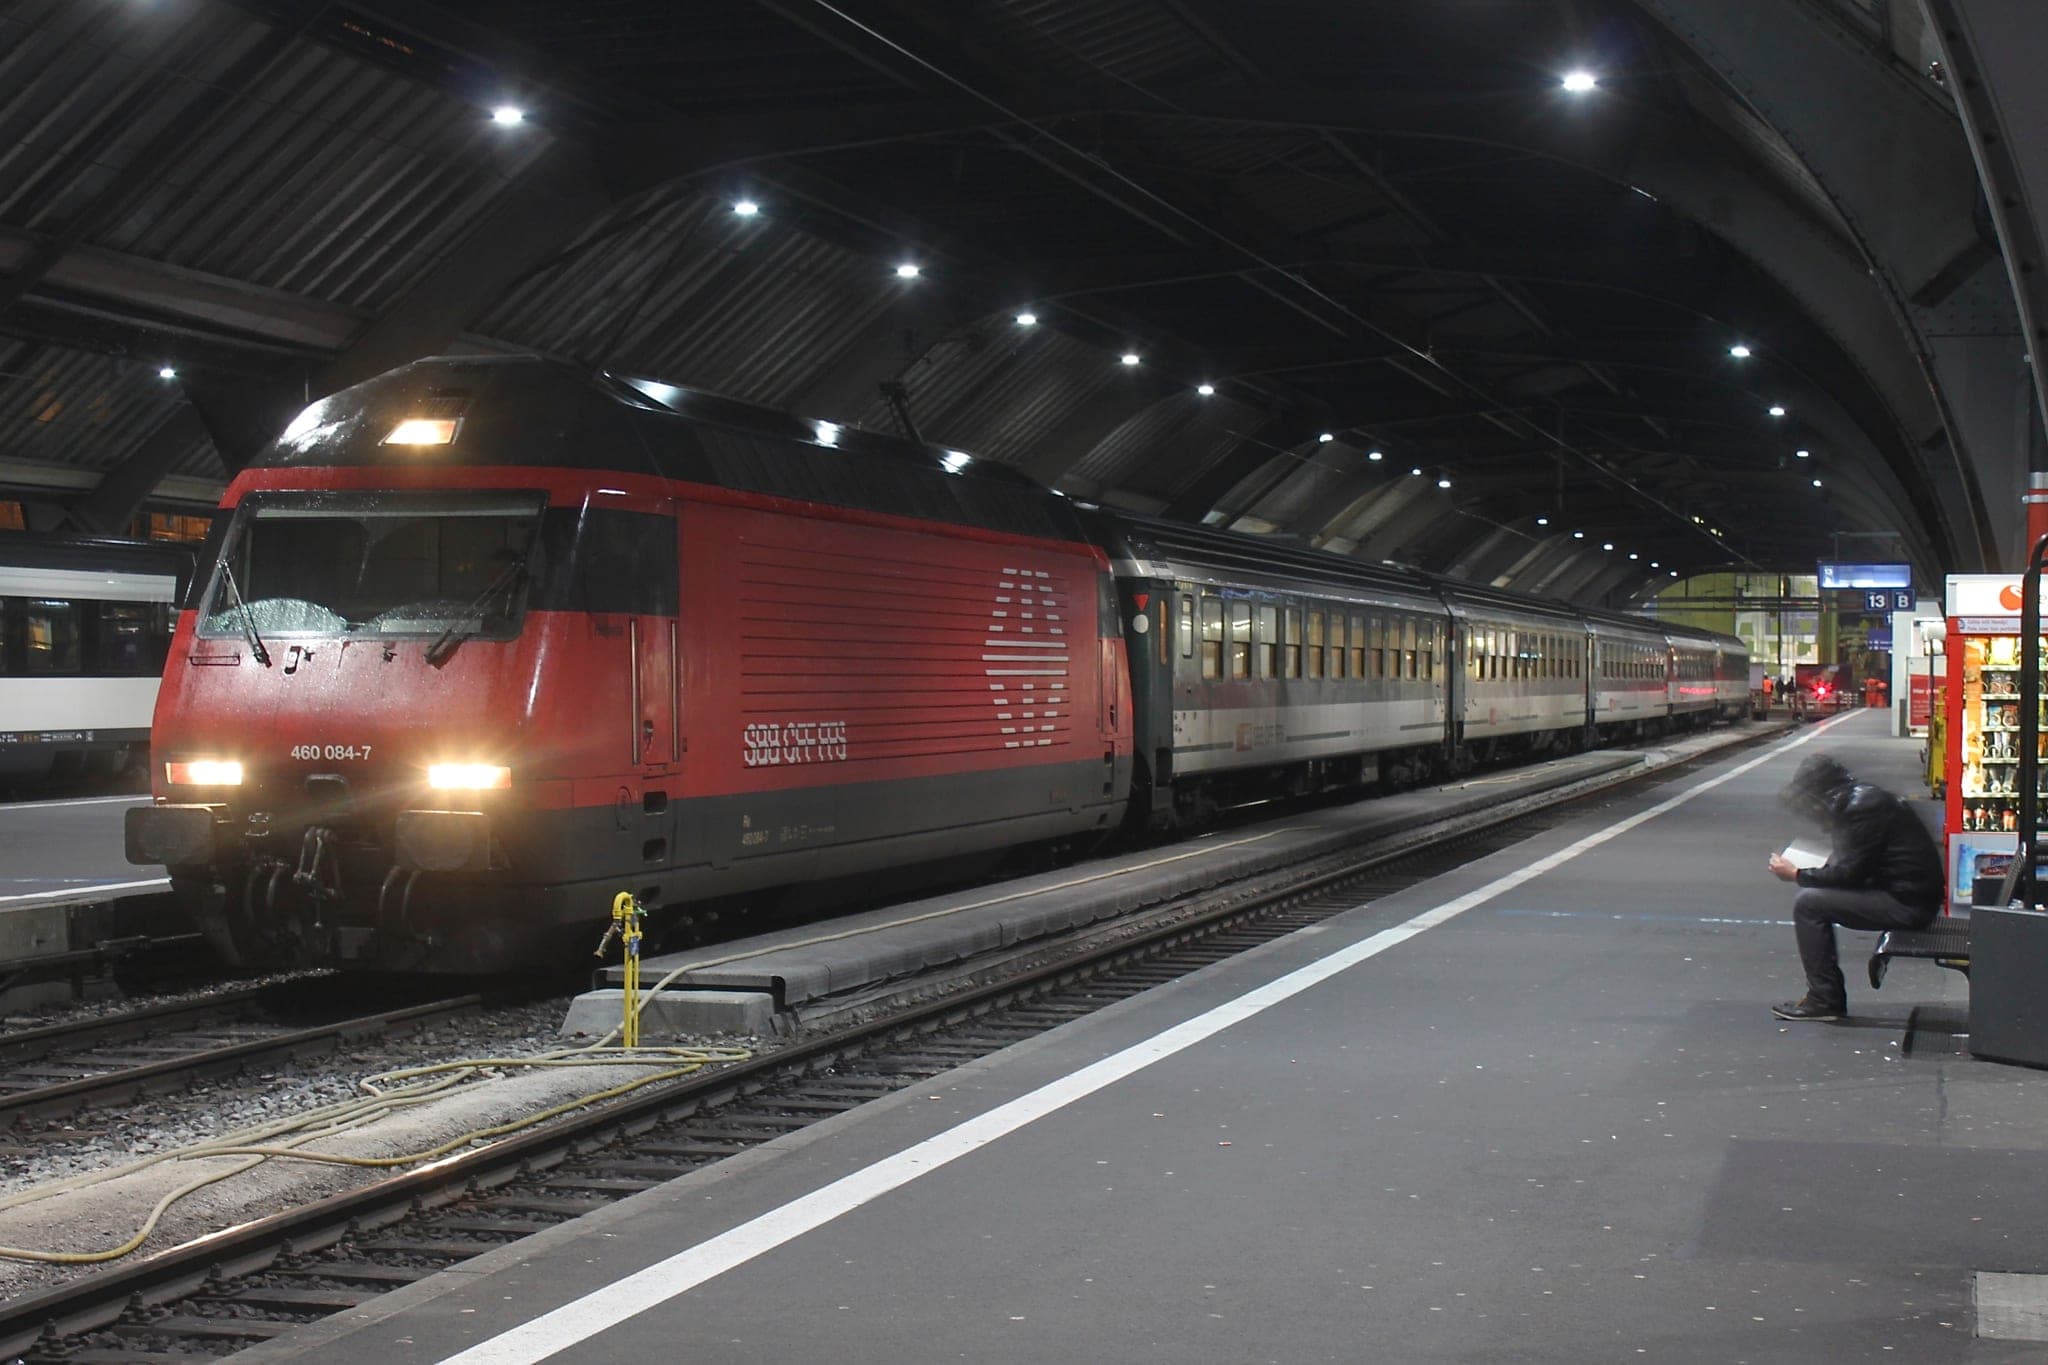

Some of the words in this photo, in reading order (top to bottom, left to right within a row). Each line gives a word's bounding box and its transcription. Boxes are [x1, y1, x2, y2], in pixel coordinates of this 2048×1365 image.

[1869, 594, 1885, 608] 13
[1898, 595, 1908, 608] B
[744, 723, 781, 766] SBB
[783, 722, 816, 763] CFF
[818, 721, 847, 761] FFS
[291, 745, 320, 760] 460
[324, 745, 372, 760] 084-7
